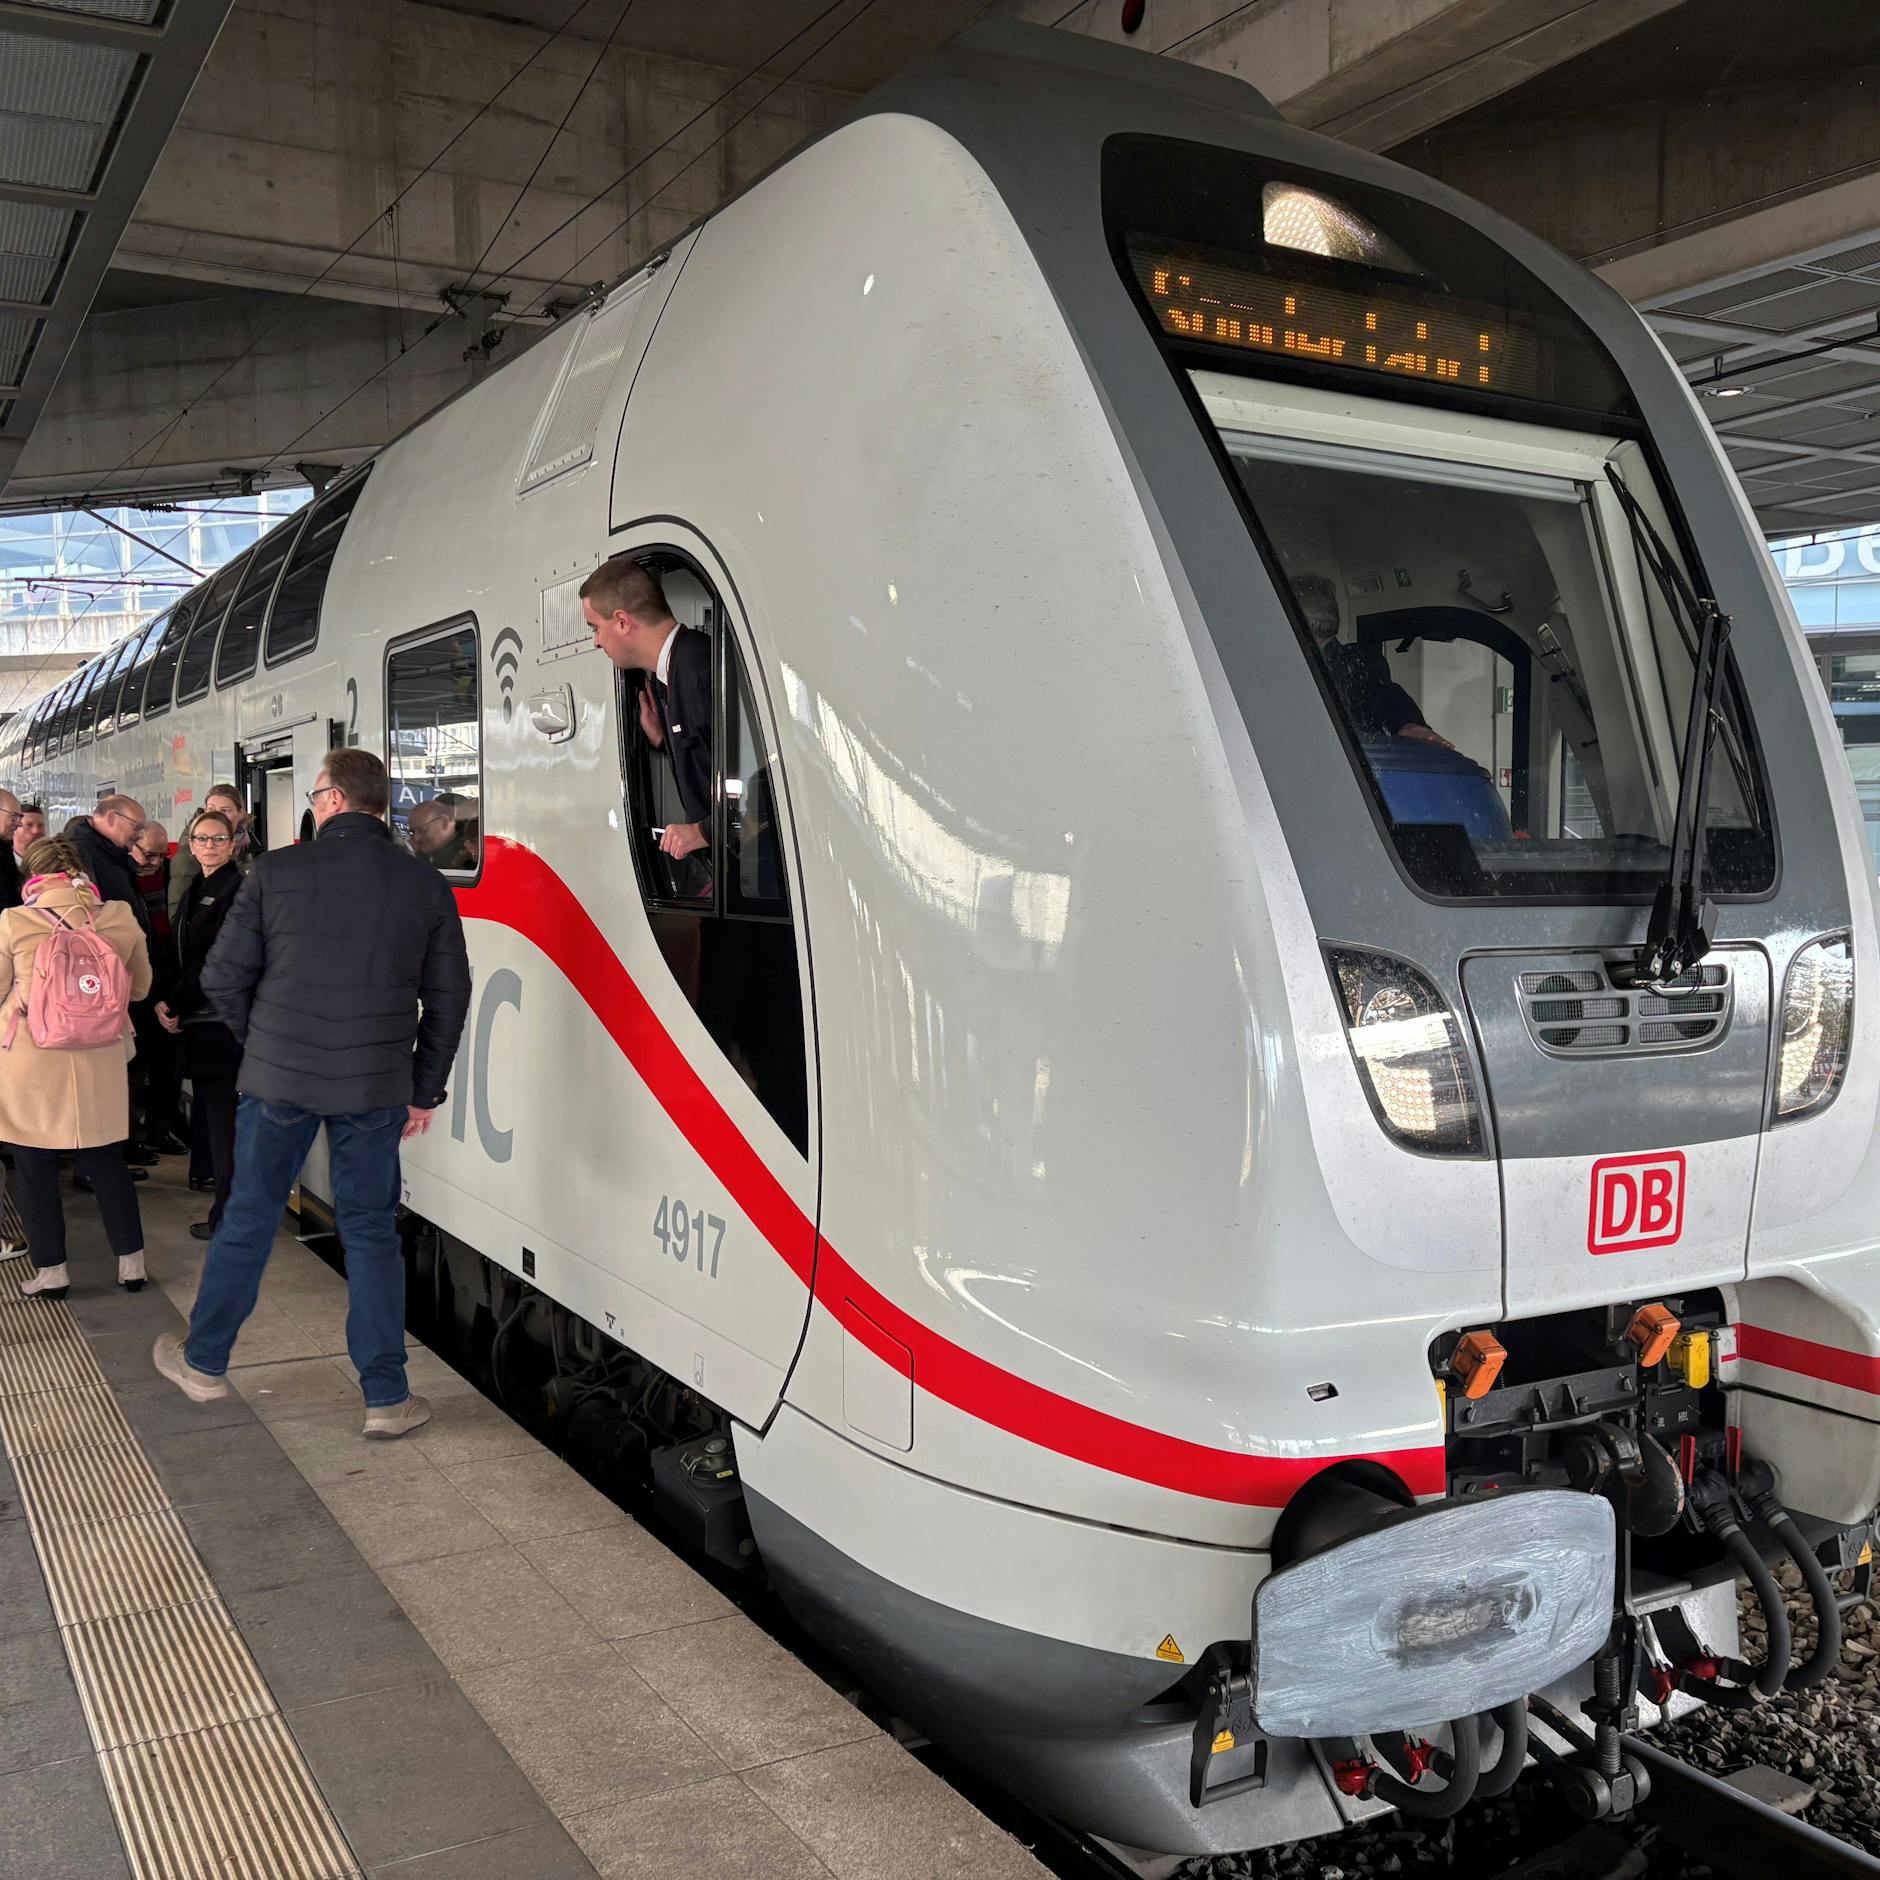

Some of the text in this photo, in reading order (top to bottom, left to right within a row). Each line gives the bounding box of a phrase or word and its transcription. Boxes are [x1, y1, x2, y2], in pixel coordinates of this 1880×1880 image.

[346, 677, 359, 746] 2
[451, 965, 523, 1164] IC
[653, 1194, 727, 1280] 4917
[1599, 1165, 1675, 1241] DB
